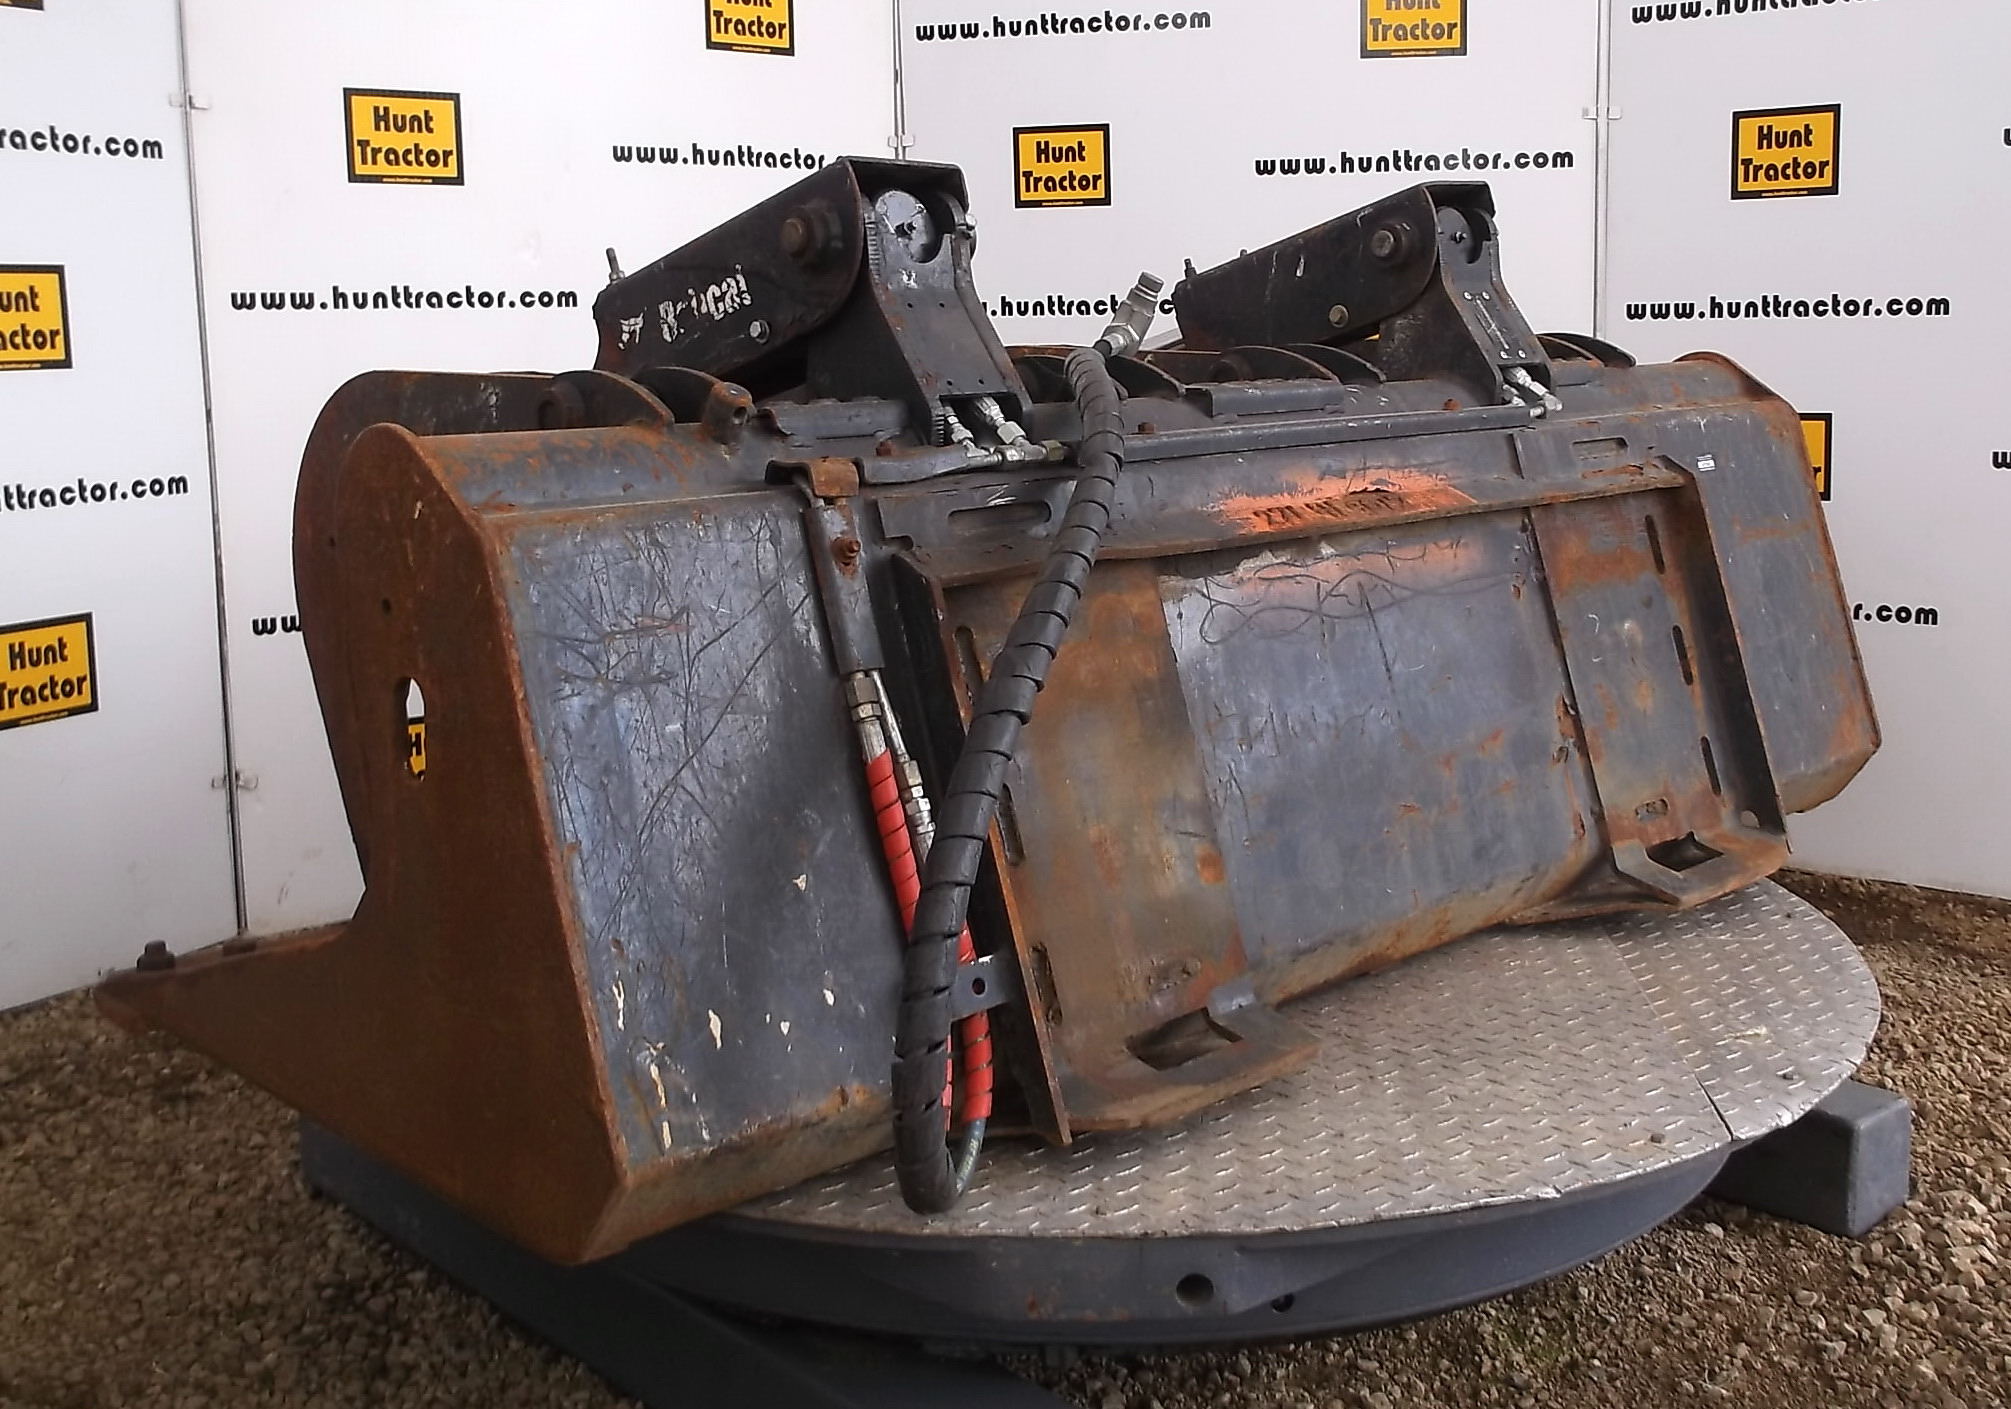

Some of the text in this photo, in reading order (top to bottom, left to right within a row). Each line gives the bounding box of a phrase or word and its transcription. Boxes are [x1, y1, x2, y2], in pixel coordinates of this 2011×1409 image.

[713, 10, 787, 39] Tractor
[915, 10, 1211, 41] www.hunttractor.com
[1369, 17, 1458, 42] Tractor
[373, 105, 434, 134] Hunt
[1756, 123, 1813, 150] Hunt
[356, 138, 453, 168] Tractor
[1035, 140, 1086, 164] Hunt
[1255, 148, 1574, 175] www.hunttractor.com
[1022, 169, 1102, 193] Tractor
[1740, 156, 1830, 183] Tractor
[230, 285, 579, 310] www.hunttractor.com
[1625, 293, 1950, 320] www.hunttractor.com
[8, 636, 69, 672] Hunt
